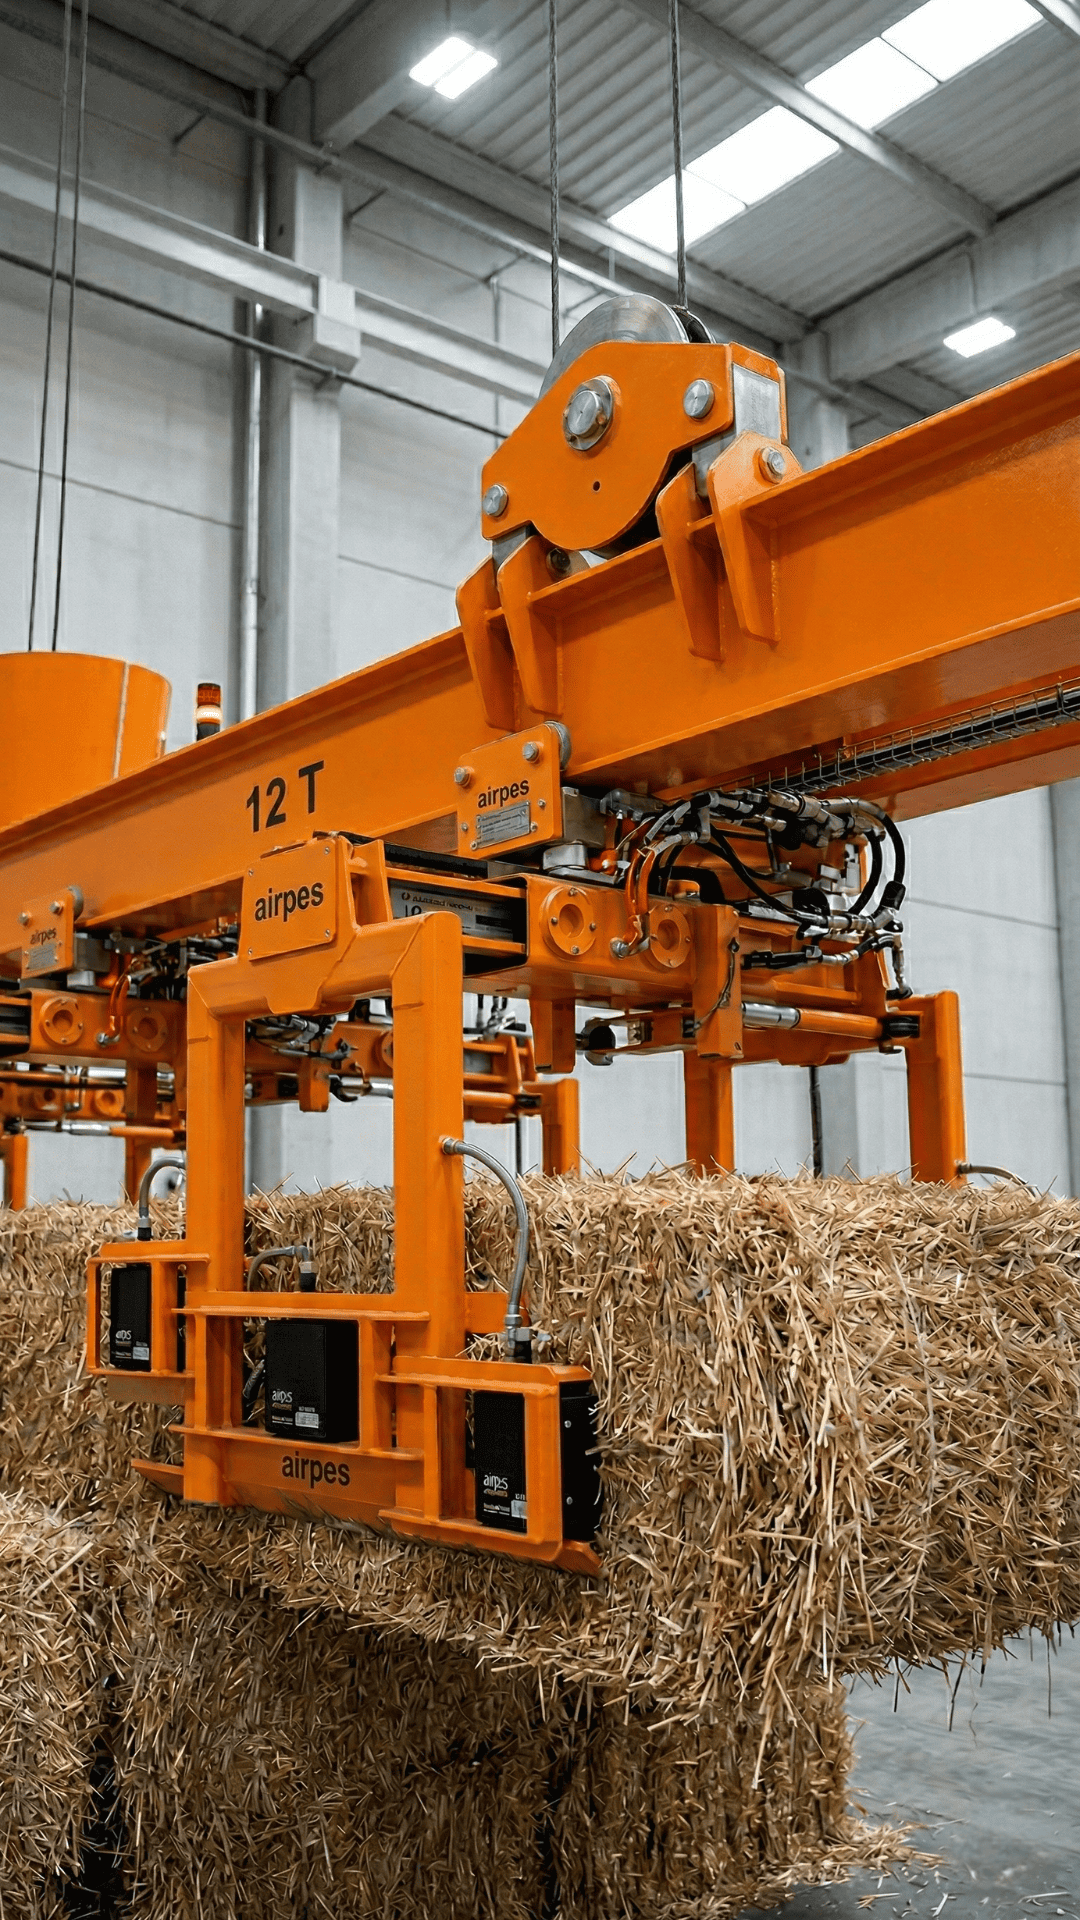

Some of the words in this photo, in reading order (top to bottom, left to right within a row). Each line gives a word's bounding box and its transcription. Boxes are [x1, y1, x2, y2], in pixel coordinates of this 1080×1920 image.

[246, 777, 286, 833] 12
[298, 760, 325, 814] T
[478, 780, 529, 808] airpes
[254, 882, 324, 922] airpes
[281, 1450, 350, 1489] airpes
